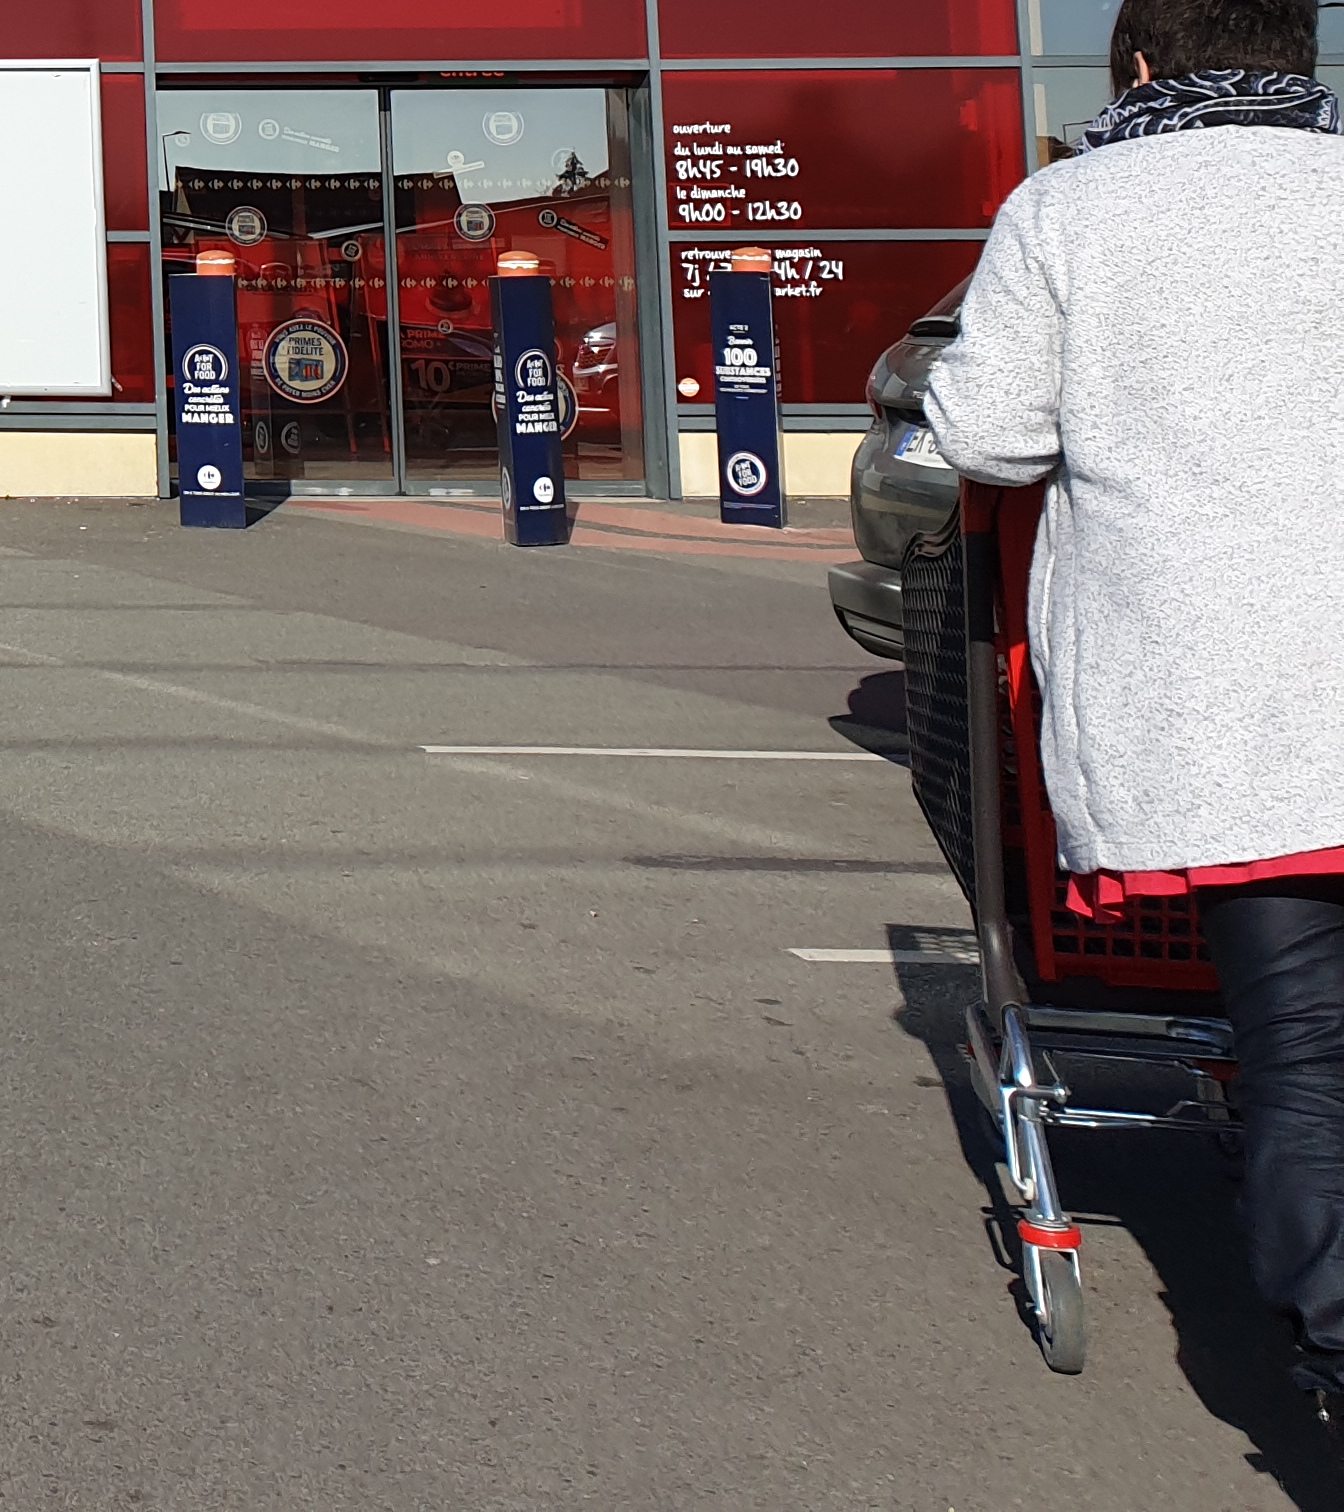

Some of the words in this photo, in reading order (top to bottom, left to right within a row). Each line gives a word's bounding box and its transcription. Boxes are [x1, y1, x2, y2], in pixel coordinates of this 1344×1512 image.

[672, 121, 732, 135] ouverture
[673, 142, 691, 156] du
[693, 141, 724, 156] lundi
[726, 146, 744, 156] au
[744, 140, 785, 156] samed
[675, 159, 724, 181] 8h45
[744, 157, 800, 179] 19h30
[676, 186, 687, 200] le
[690, 184, 747, 200] dimanche
[678, 202, 726, 223] 9h00
[747, 200, 803, 222] 12h30
[680, 246, 732, 261] retrouve
[774, 246, 823, 263] magasin
[681, 262, 701, 287] 7j
[818, 260, 844, 281] 24
[683, 287, 705, 298] sur
[288, 336, 323, 347] PRIMES
[723, 347, 759, 367] 100
[196, 362, 213, 371] FOR
[715, 366, 772, 377] SUBSTANCES
[194, 370, 216, 380] FOOD
[527, 377, 546, 388] FOOD
[181, 412, 235, 424] MANGER
